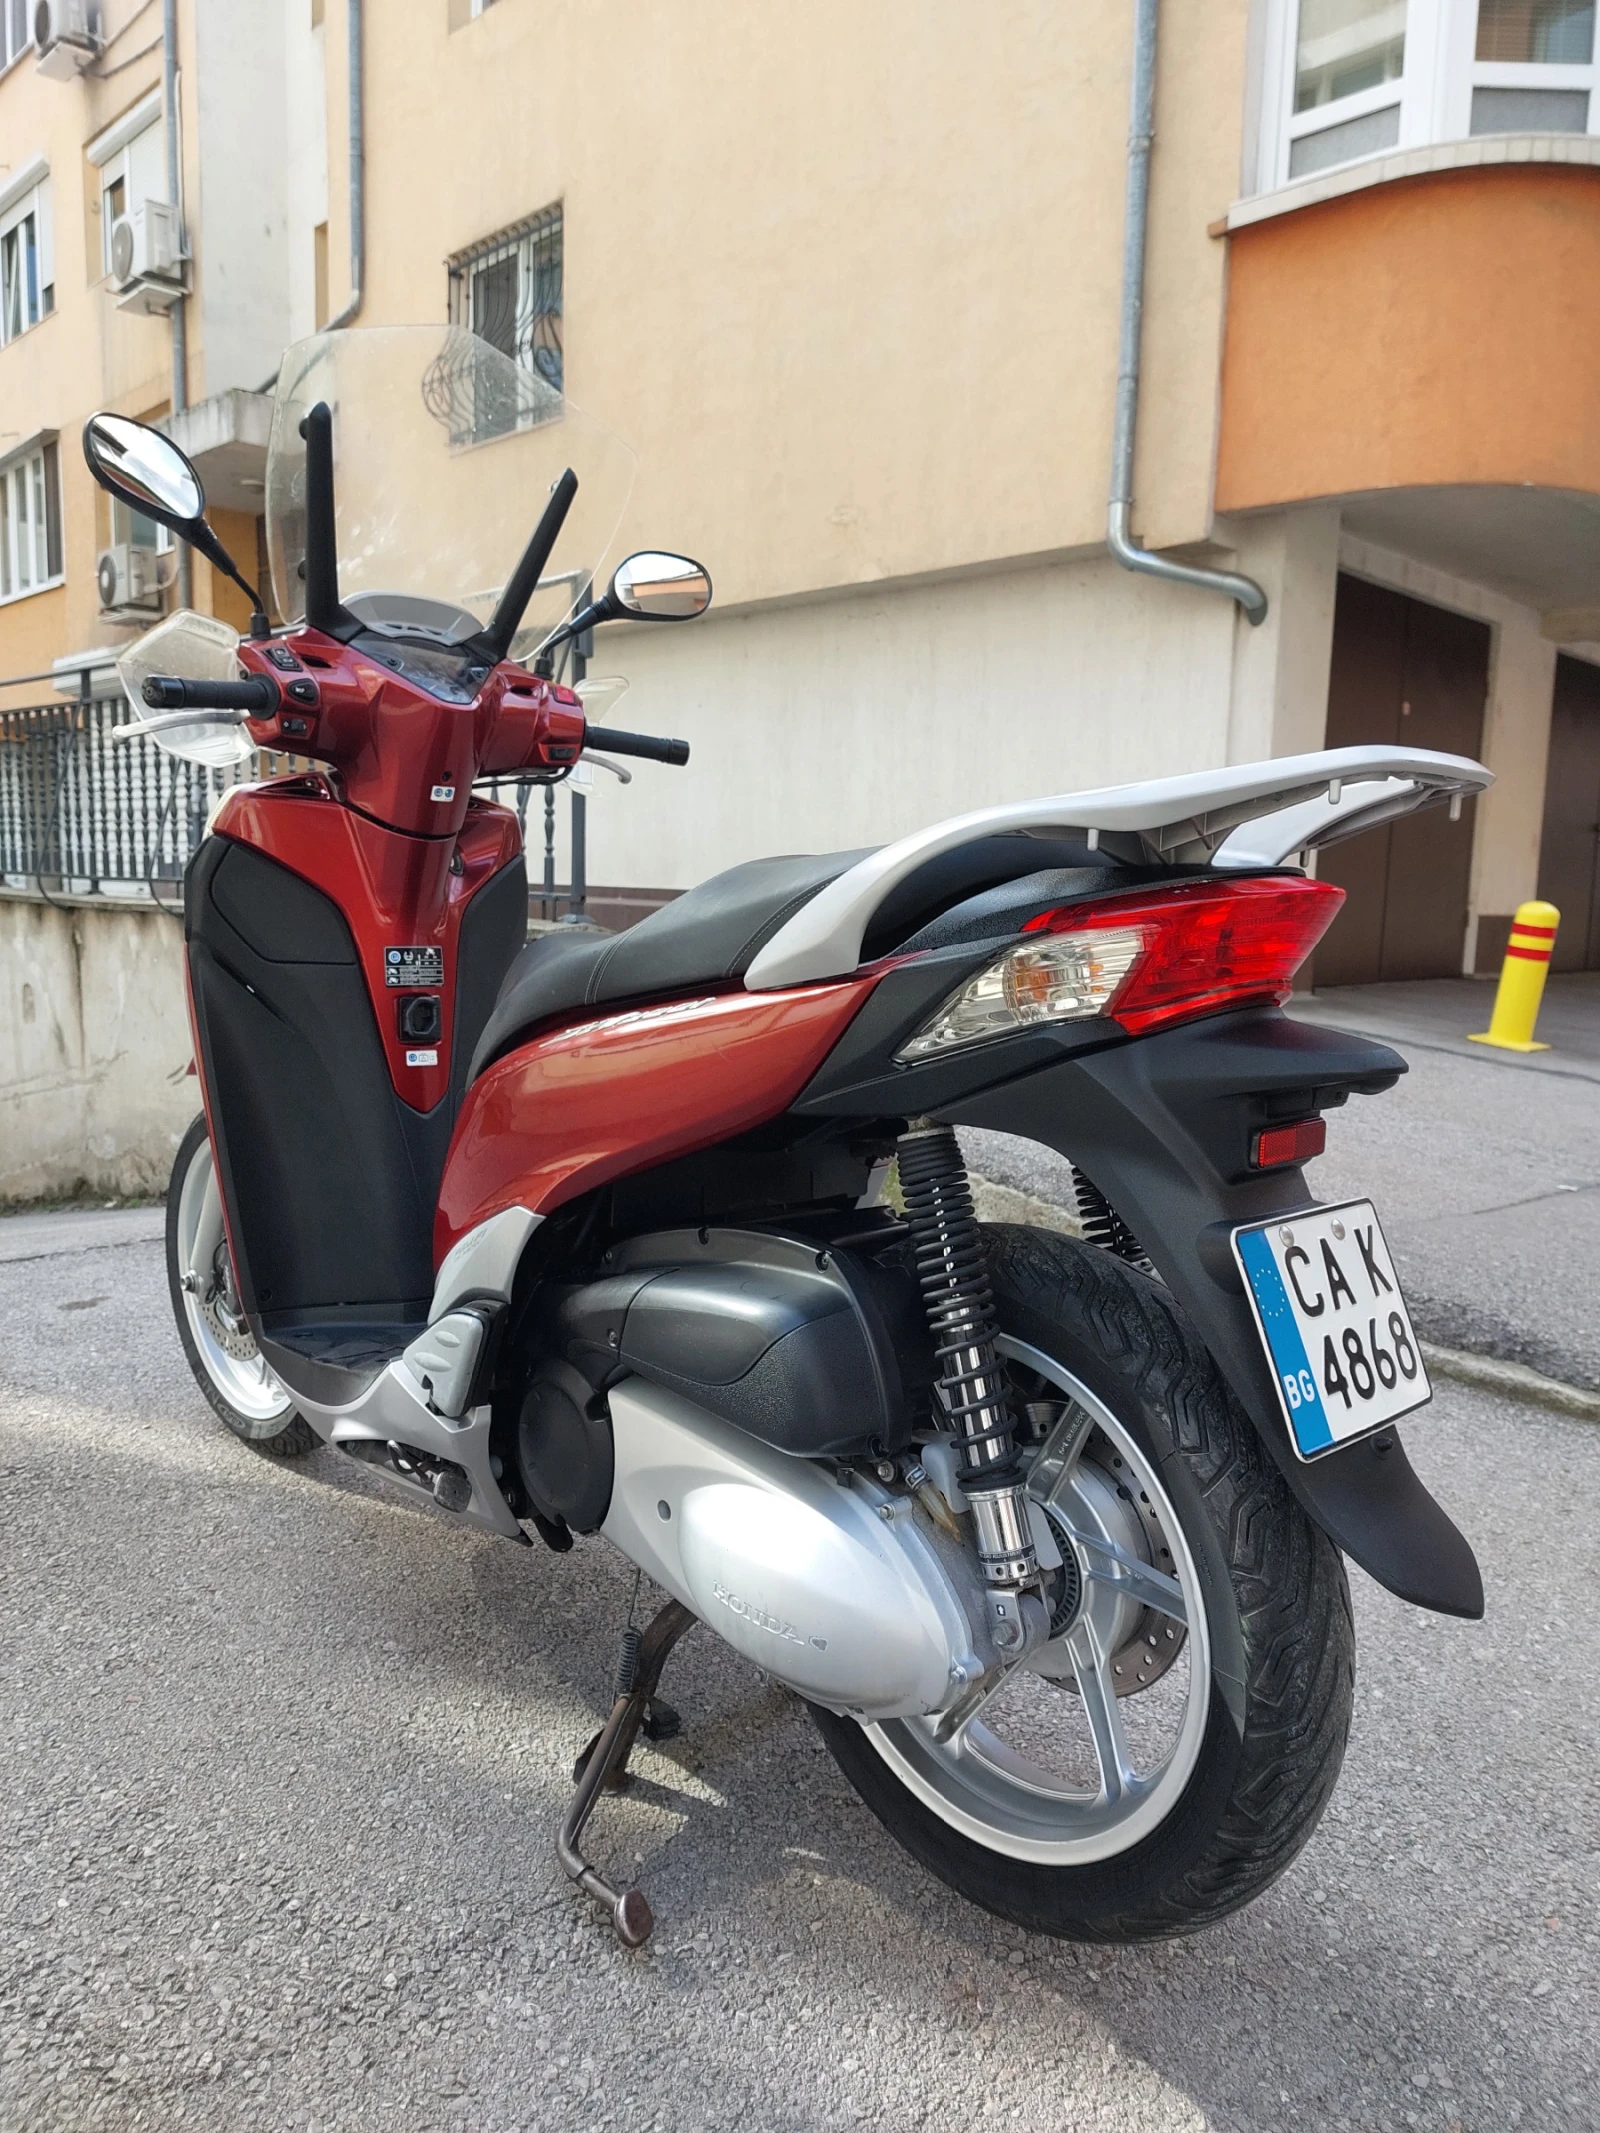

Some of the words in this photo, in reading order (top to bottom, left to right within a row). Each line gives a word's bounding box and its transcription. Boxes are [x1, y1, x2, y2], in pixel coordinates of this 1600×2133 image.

[1285, 1238, 1356, 1317] CA
[1354, 1224, 1393, 1297] K
[1284, 1369, 1315, 1409] BG
[1324, 1311, 1417, 1408] 4868
[713, 1580, 805, 1645] HONDA
